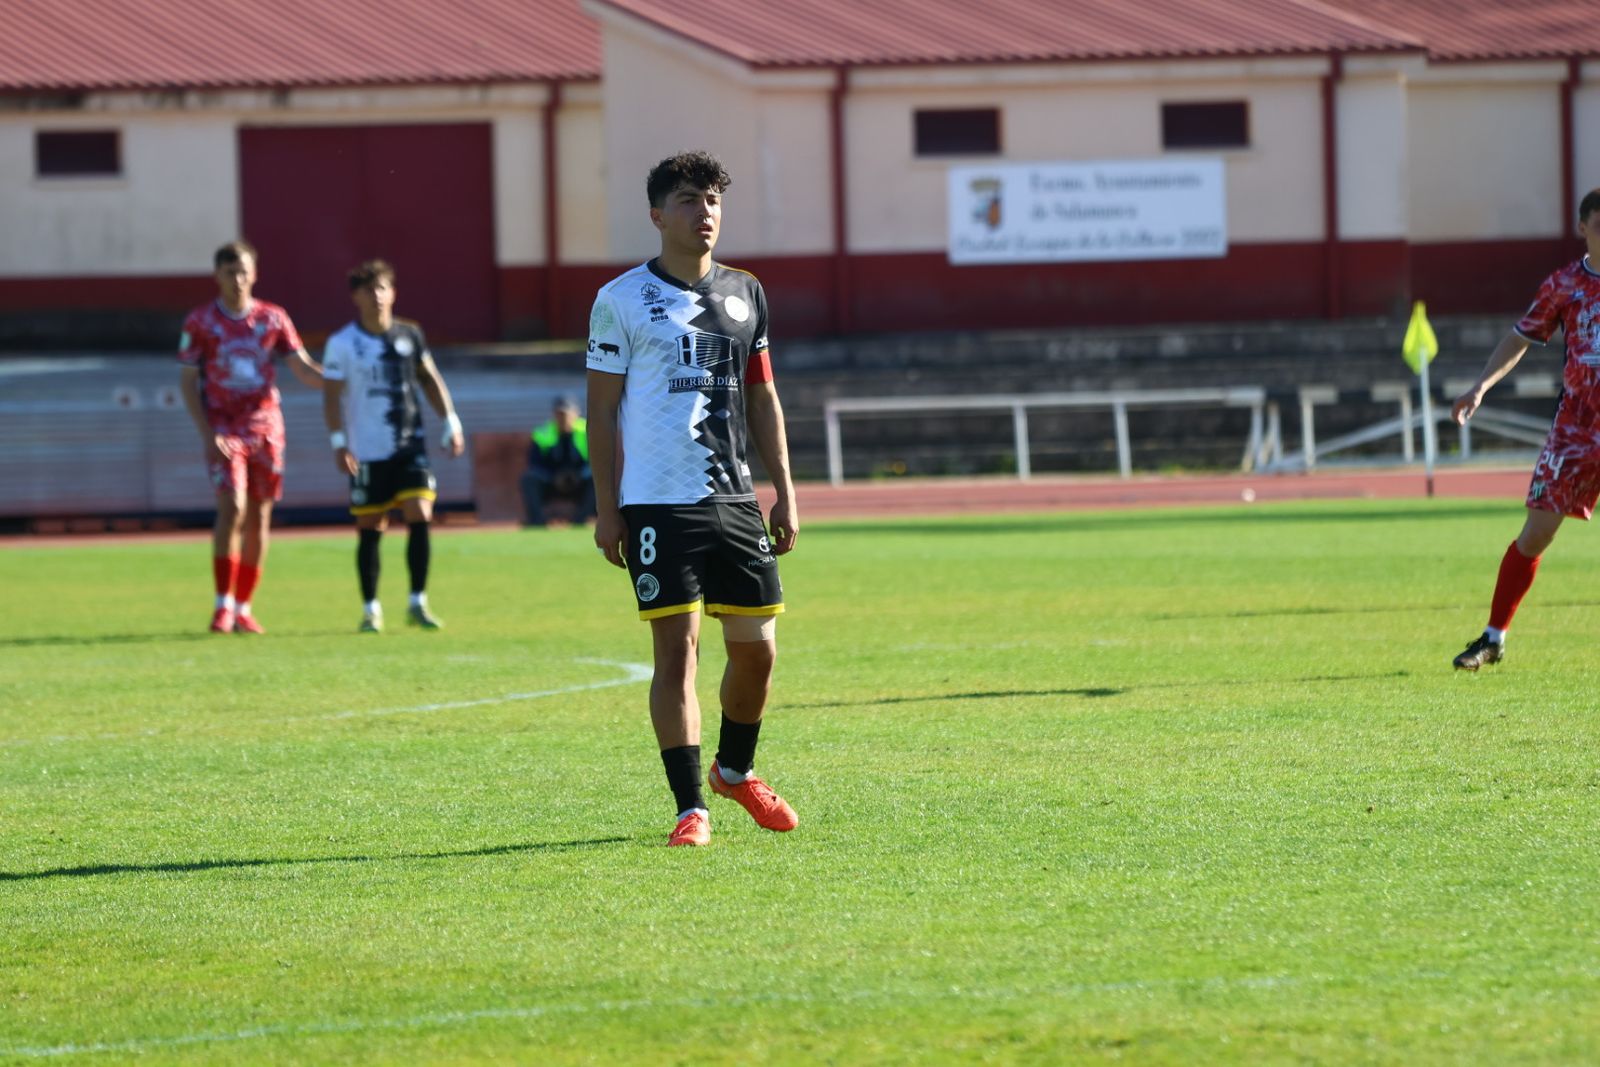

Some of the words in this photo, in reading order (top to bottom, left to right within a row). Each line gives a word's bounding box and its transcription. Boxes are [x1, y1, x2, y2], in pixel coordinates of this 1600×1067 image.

[670, 376, 715, 388] HIERROS
[717, 374, 739, 386] DÍAZ
[1536, 449, 1564, 480] 24
[639, 525, 657, 566] 8
